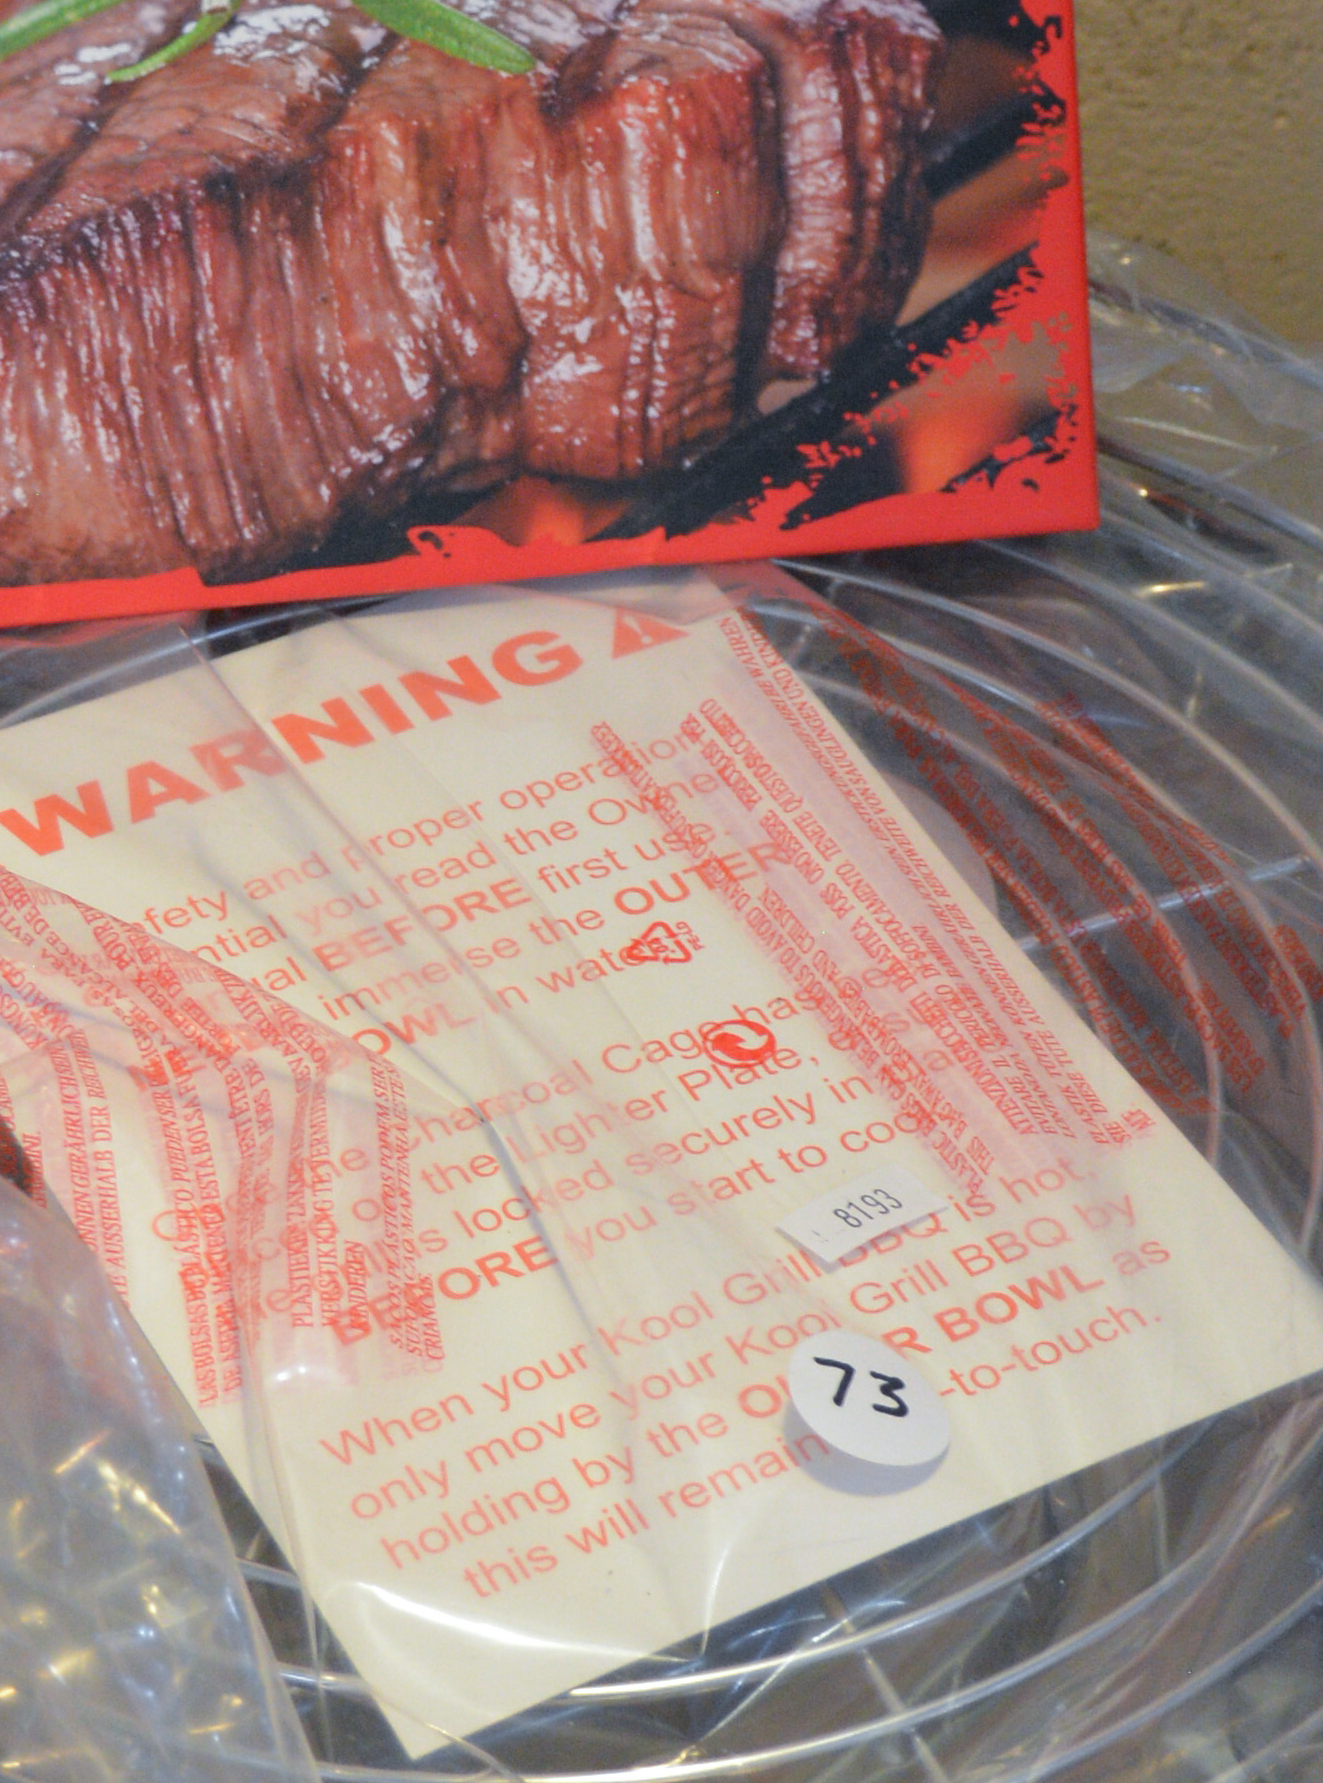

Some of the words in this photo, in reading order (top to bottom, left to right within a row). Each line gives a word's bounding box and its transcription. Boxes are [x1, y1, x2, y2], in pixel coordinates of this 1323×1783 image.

[240, 850, 327, 903] and
[342, 797, 492, 879] proper
[293, 882, 389, 946] you
[390, 838, 497, 898] read
[502, 808, 581, 861] the
[792, 809, 841, 863] TENETE
[879, 811, 951, 904] REICHWEITE
[310, 874, 533, 976] BEFORE
[533, 837, 638, 898] first
[742, 904, 788, 954] AVOID
[942, 898, 975, 936] DER
[318, 927, 523, 1024] immerse
[527, 898, 606, 950] the
[480, 974, 530, 1016] in
[966, 930, 1045, 1031] AUSSERHALB
[989, 1053, 1010, 1075] IL
[1001, 1071, 1060, 1140] EVITARE
[1065, 1064, 1110, 1118] DIESE
[90, 1105, 112, 1144] DER
[418, 1141, 502, 1199] the
[506, 1081, 676, 1174] Lighter
[457, 1158, 617, 1241] locked
[621, 1085, 821, 1185] securely
[825, 1067, 875, 1108] in
[559, 1199, 659, 1265] you
[662, 1154, 776, 1221] start
[777, 1134, 830, 1178] to
[832, 1182, 904, 1233] 8193
[319, 1383, 476, 1472] When
[482, 1342, 597, 1418] your
[595, 1286, 716, 1361] Kool
[719, 1246, 825, 1312] Grill
[951, 1182, 999, 1224] is
[345, 1457, 456, 1528] only
[461, 1397, 604, 1476] move
[607, 1348, 724, 1425] your
[845, 1254, 951, 1323] Grill
[950, 1208, 1074, 1282] BBQ
[1073, 1187, 1140, 1241] by
[379, 1468, 572, 1573] holding
[572, 1440, 640, 1499] by
[644, 1398, 731, 1462] the
[935, 1255, 1106, 1347] BOWL
[1110, 1236, 1174, 1281] as
[811, 1357, 909, 1416] 73
[461, 1536, 563, 1605] this
[561, 1496, 651, 1559] will
[654, 1425, 831, 1521] remain
[931, 1291, 1164, 1407] -to-touch.
